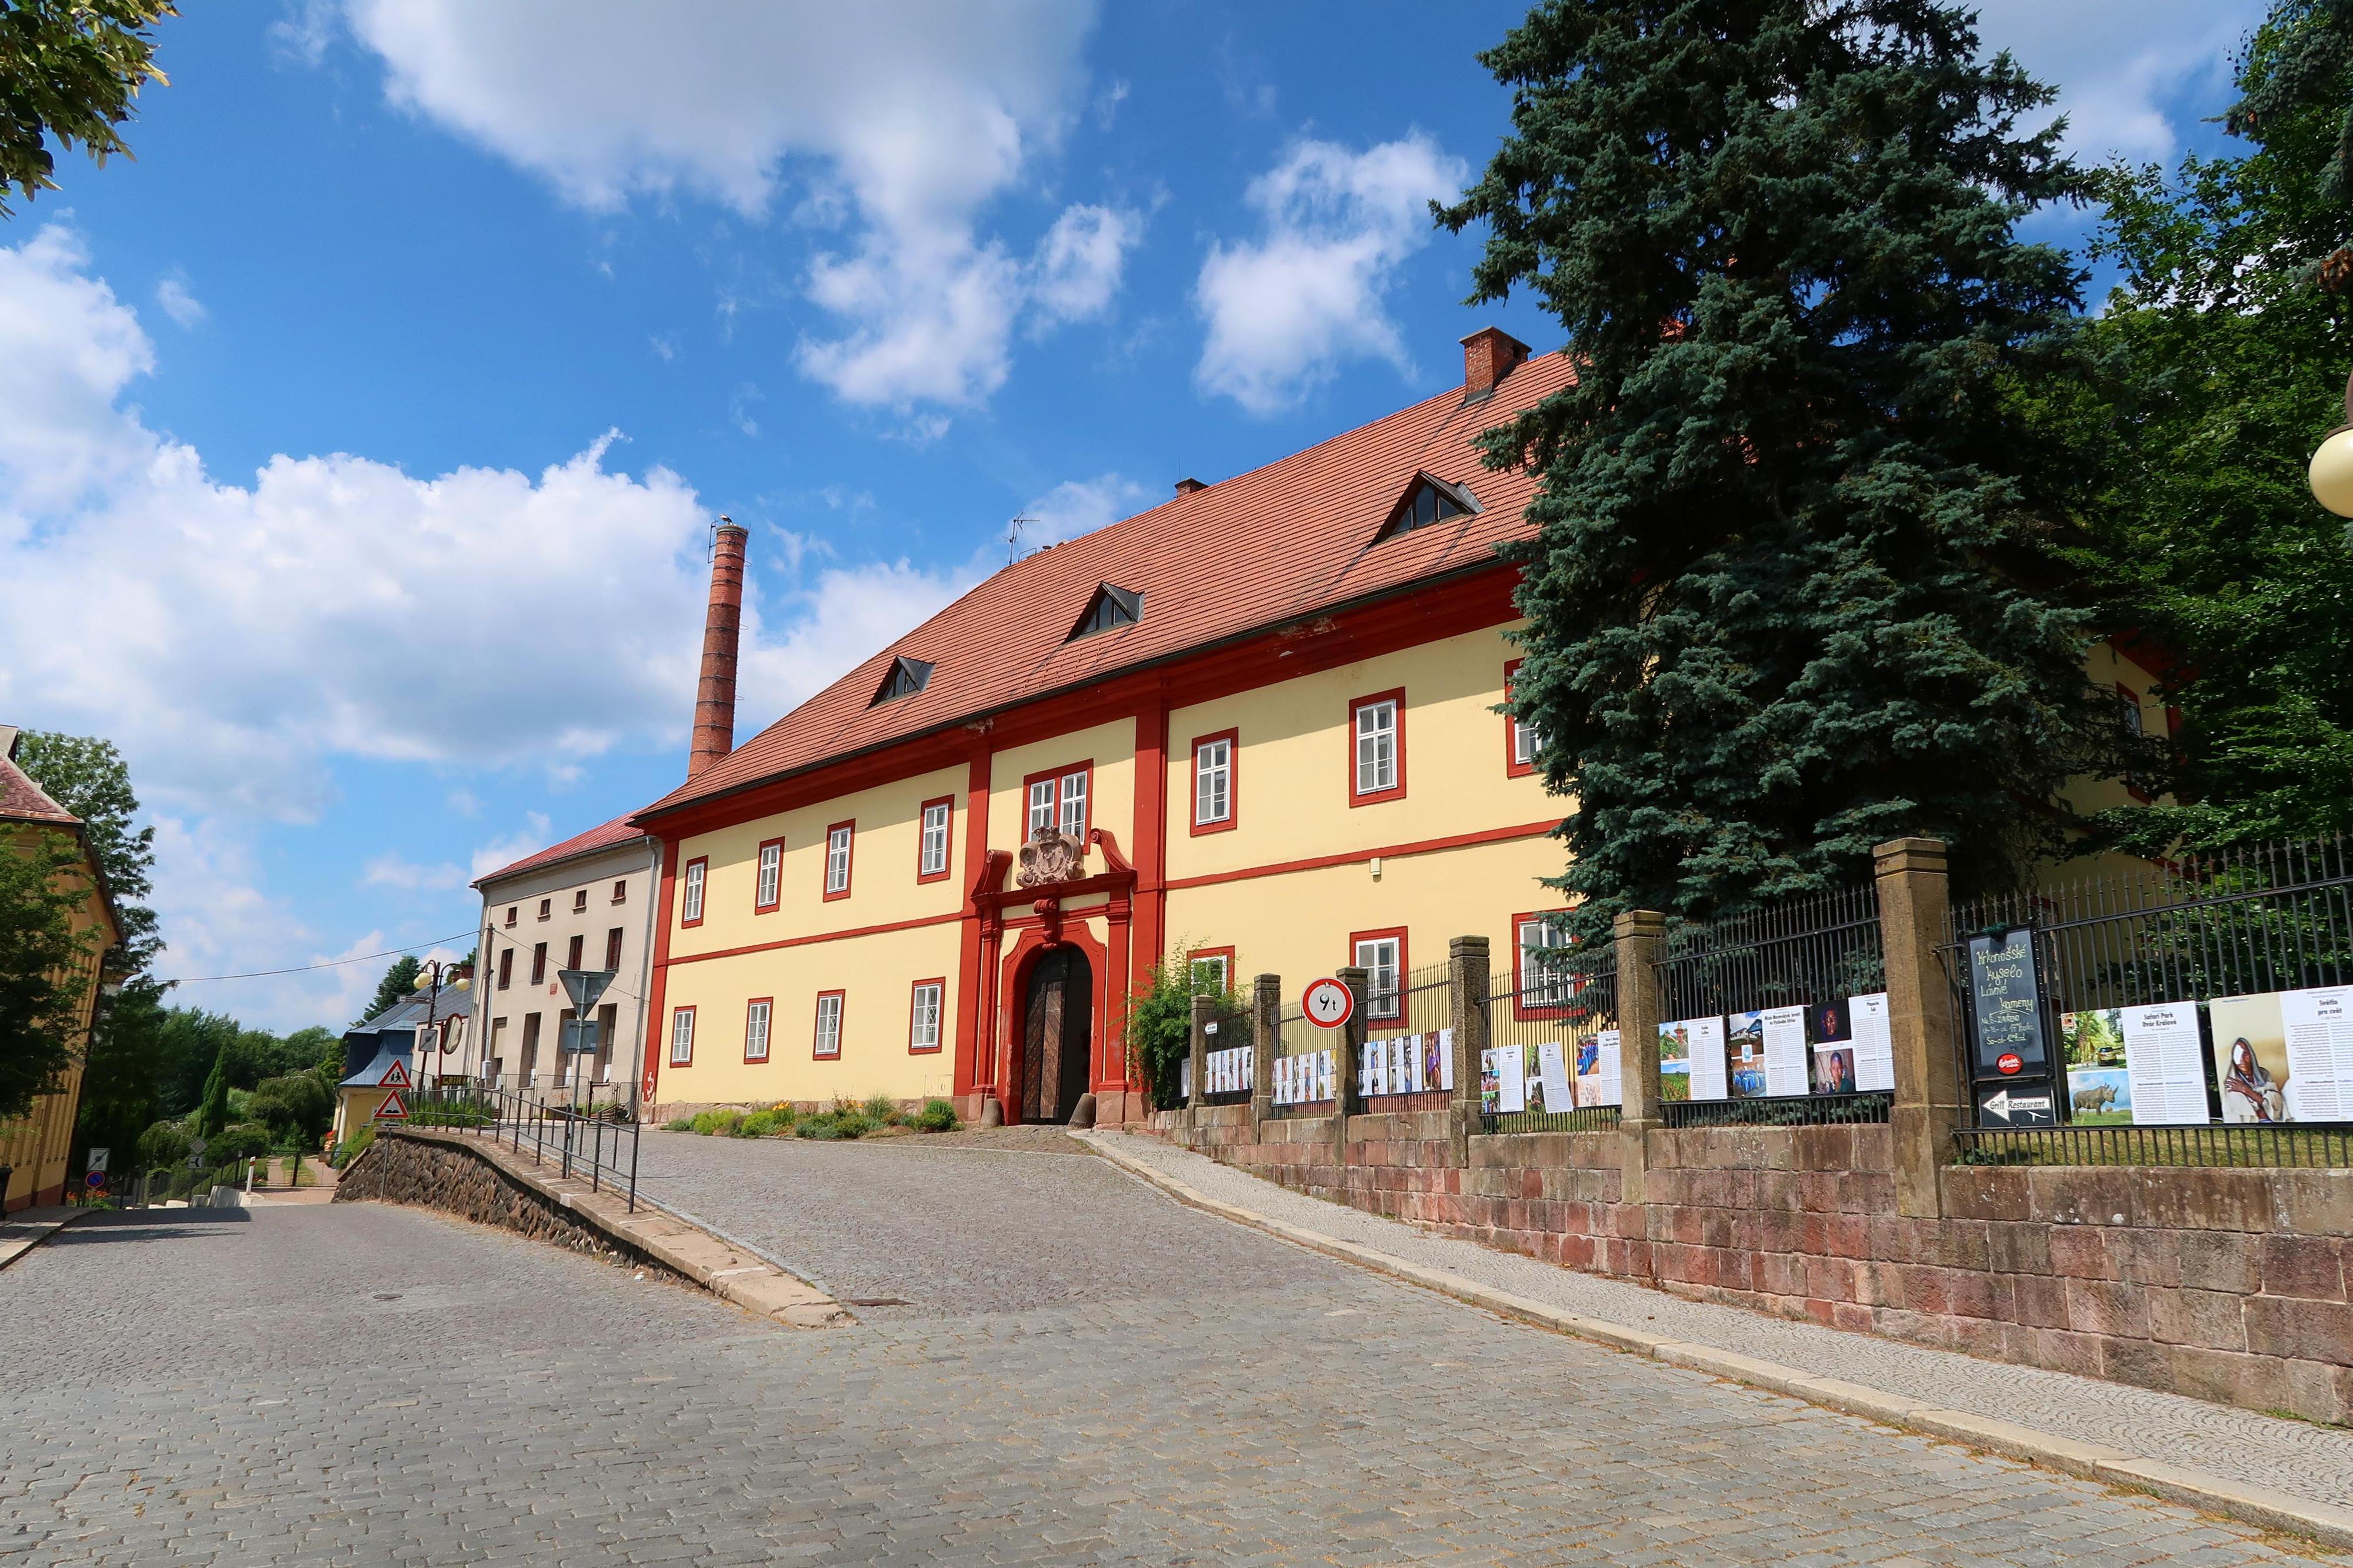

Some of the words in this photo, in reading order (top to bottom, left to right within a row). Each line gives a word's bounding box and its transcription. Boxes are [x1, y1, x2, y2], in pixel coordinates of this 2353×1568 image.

[1977, 944, 2027, 965] Krkonošské
[1986, 965, 2022, 986] kyselo
[1999, 997, 2033, 1012] kameny
[1990, 1100, 2004, 1110] Grill
[2008, 1100, 2045, 1109] Restaurant
